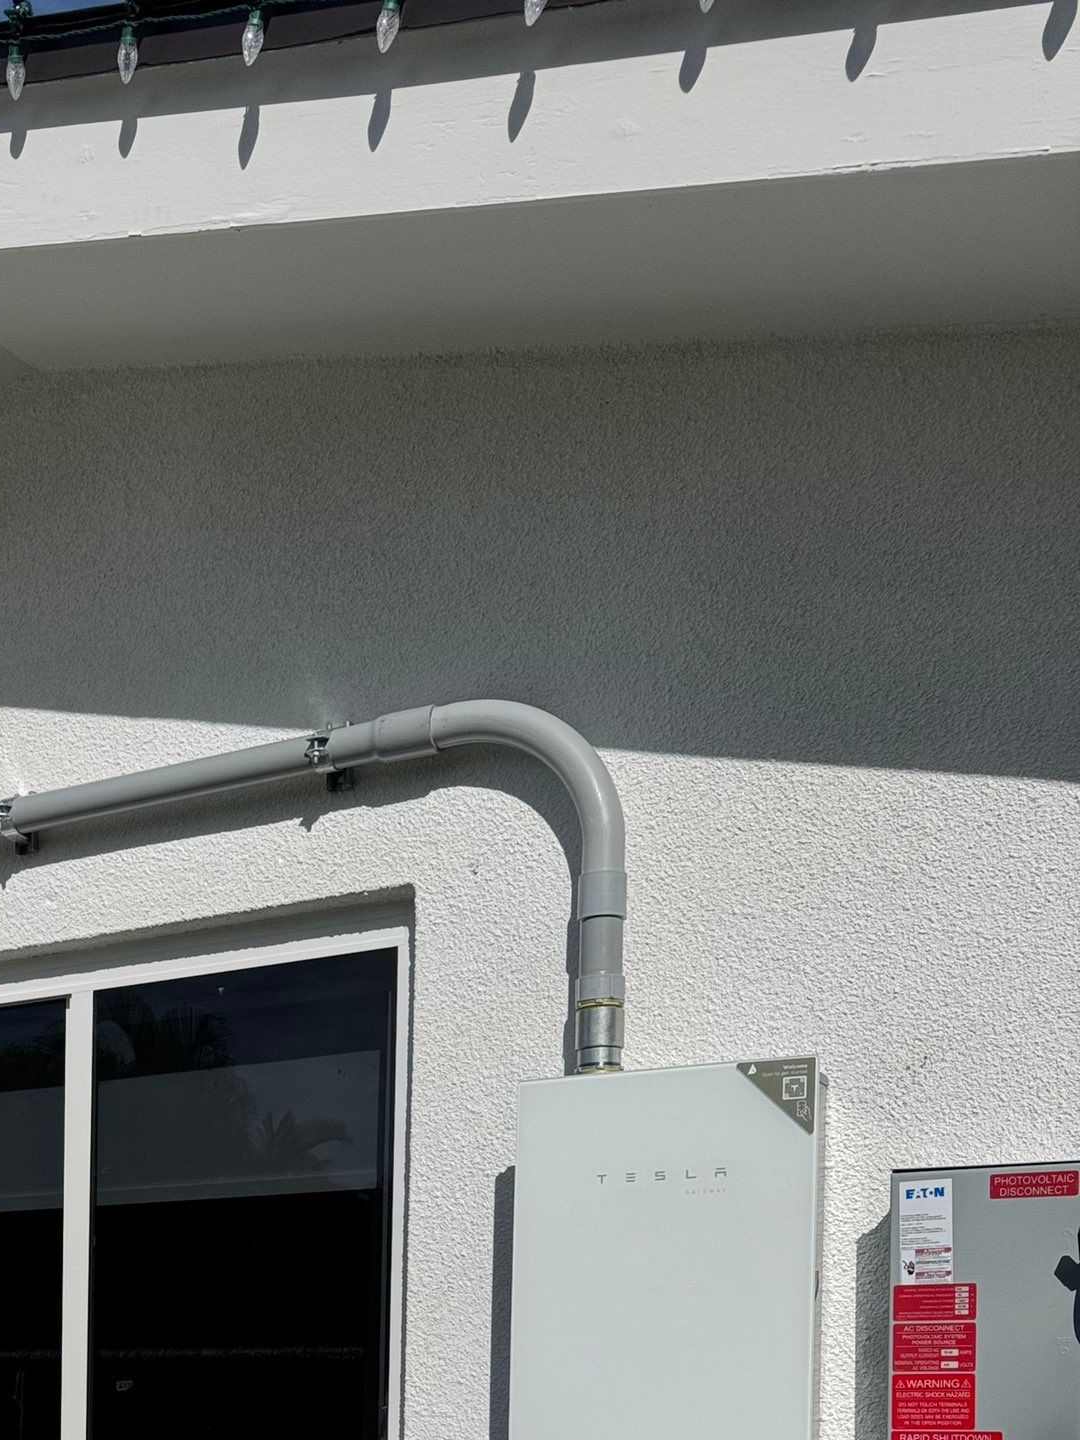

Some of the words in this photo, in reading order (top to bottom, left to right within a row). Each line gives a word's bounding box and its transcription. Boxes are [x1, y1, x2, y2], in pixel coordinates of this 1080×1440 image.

[597, 1167, 727, 1184] TESLA
[994, 1174, 1075, 1186] PHOTOVOLTAIC
[906, 1187, 944, 1200] EATON
[1000, 1186, 1069, 1196] DISCONNECT
[906, 1380, 960, 1388] WARNING
